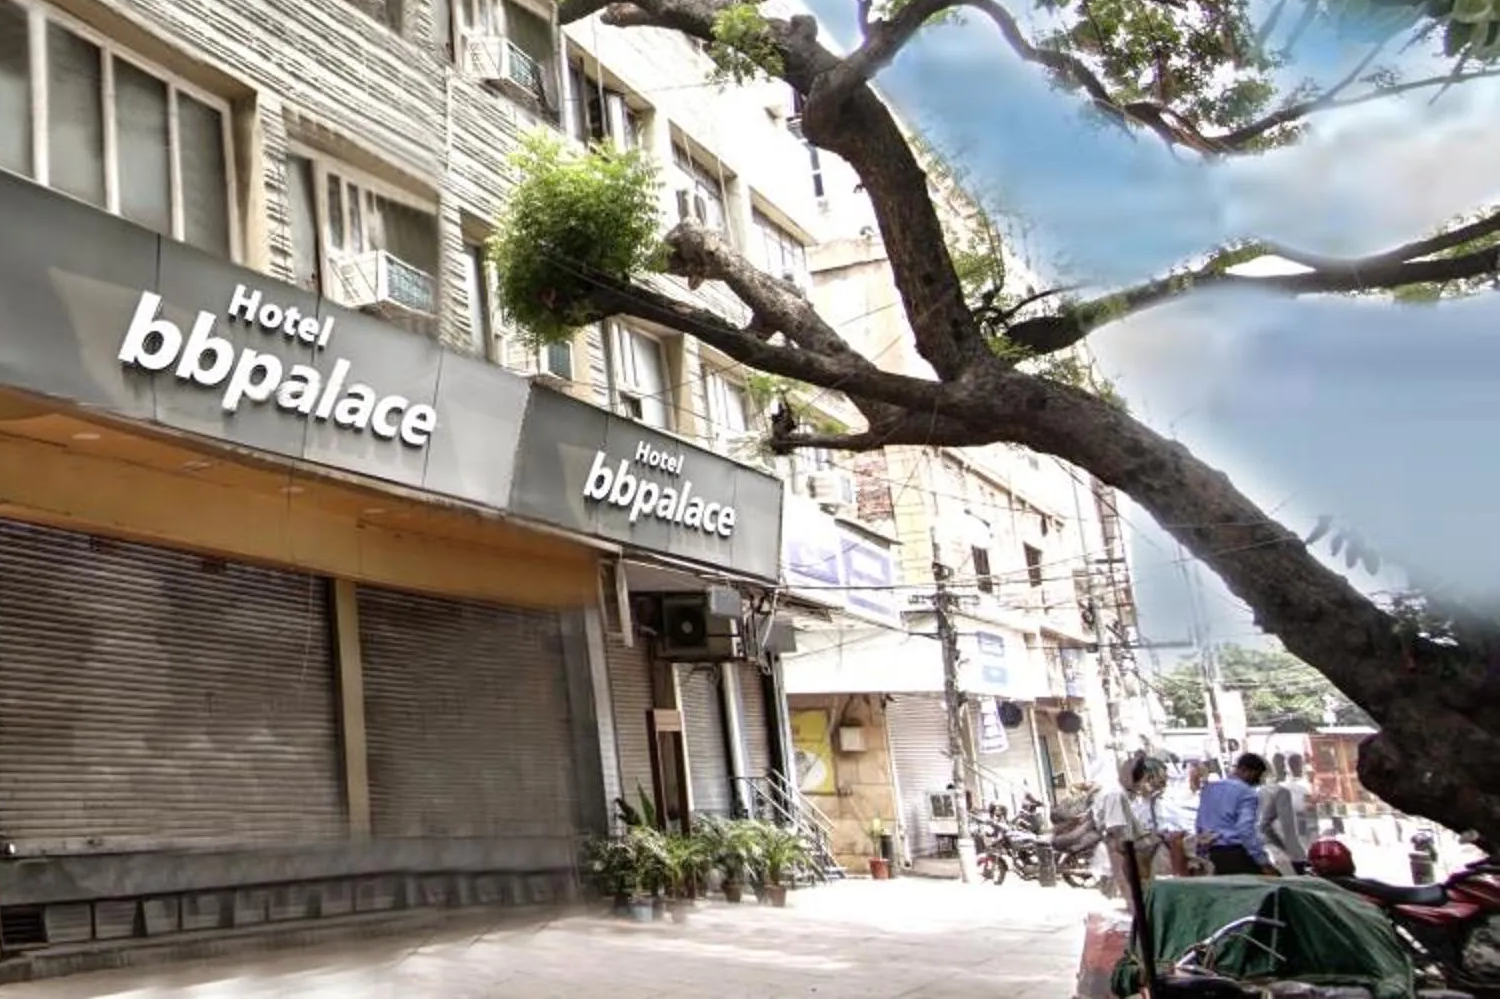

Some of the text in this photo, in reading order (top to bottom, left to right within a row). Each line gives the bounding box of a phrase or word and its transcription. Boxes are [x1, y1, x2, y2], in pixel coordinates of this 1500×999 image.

[227, 283, 335, 348] Hotel
[117, 290, 437, 446] bbpalace
[583, 450, 736, 537] bbpalace
[635, 440, 685, 475] Hotel
